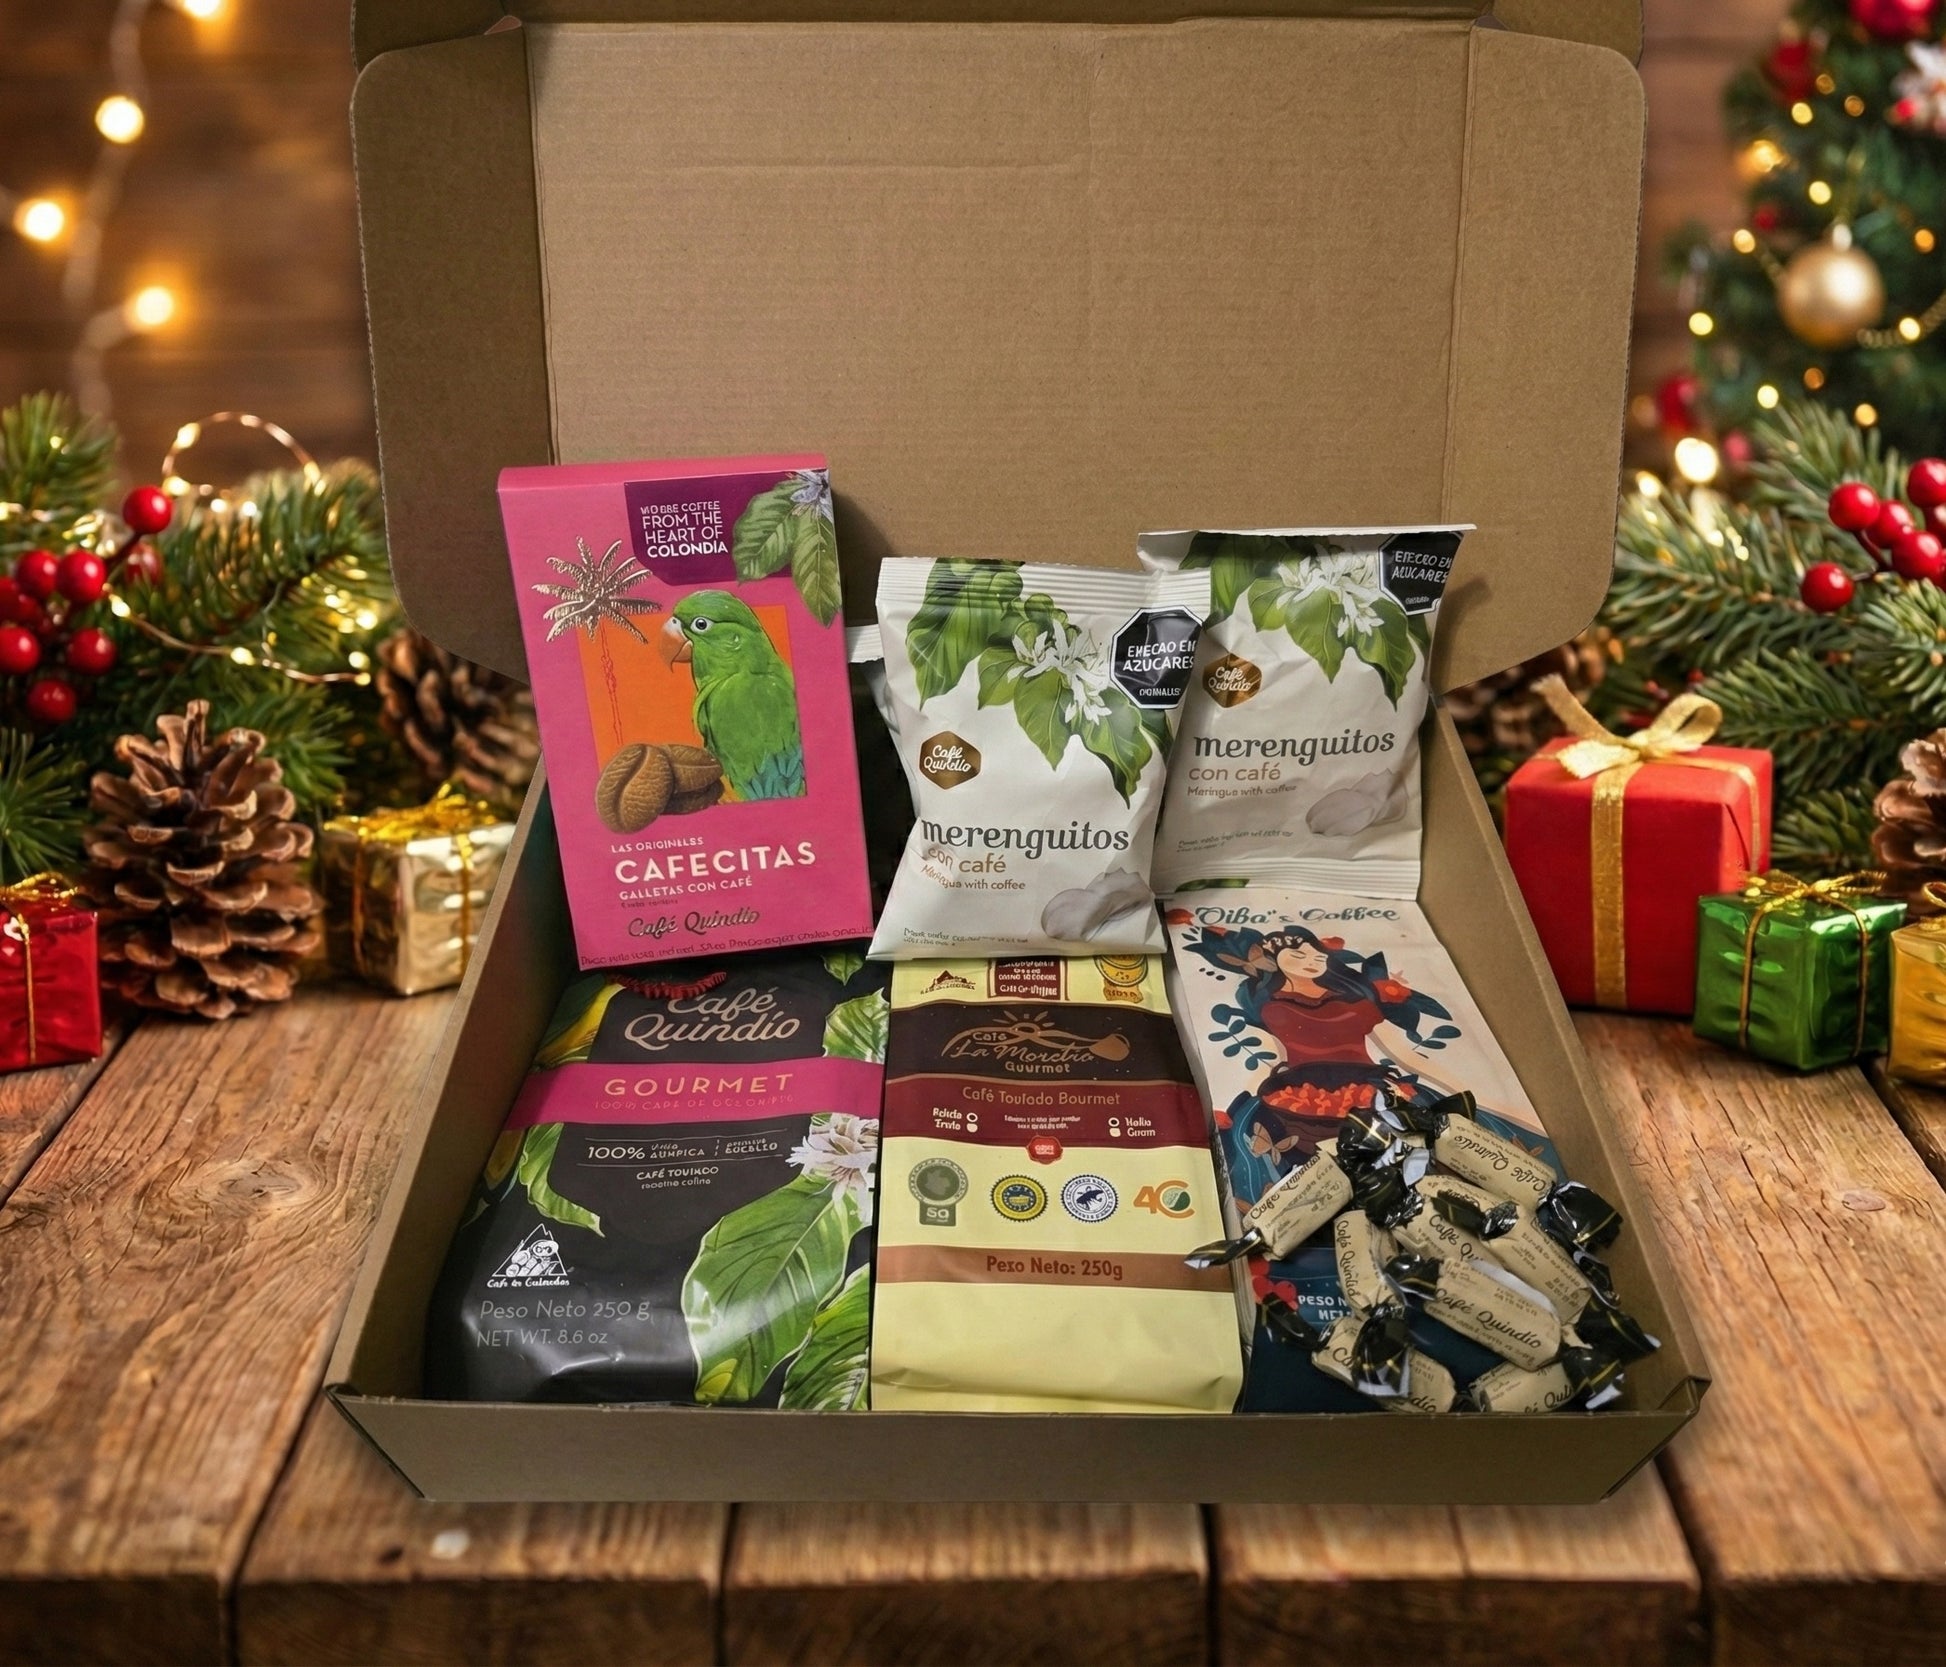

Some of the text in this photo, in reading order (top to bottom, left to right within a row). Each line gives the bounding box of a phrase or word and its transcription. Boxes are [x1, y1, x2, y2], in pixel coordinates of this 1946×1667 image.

[642, 510, 723, 530] FROM THE
[645, 525, 724, 545] HEART OF
[1123, 656, 1194, 673] AZUCARES
[1193, 728, 1396, 767] merenguitos
[1188, 761, 1281, 781] con café
[1240, 786, 1263, 796] with
[611, 843, 633, 854] LAS
[921, 819, 1130, 860] merenguitos
[615, 841, 817, 884] CAFECITAS
[958, 852, 1007, 873] café
[619, 875, 753, 901] GALLETAS CON CAFÉ
[964, 879, 989, 890] with
[990, 878, 1026, 890] coffee
[628, 915, 679, 939] Café
[624, 1011, 801, 1051] Quindío
[604, 1073, 794, 1098] GOURMET
[1058, 1091, 1121, 1105] Bourmet
[587, 1145, 646, 1160] 100%
[636, 1168, 666, 1180] CAFÉ
[1030, 1257, 1076, 1276] Neto:
[1081, 1259, 1123, 1281] 250g
[480, 1299, 651, 1321] Peso Neto 250 g
[1297, 1295, 1335, 1306] PESO
[1435, 1288, 1475, 1314] Café
[1475, 1310, 1542, 1349] Quindío
[476, 1328, 609, 1347] NET WT. 8.6 oz
